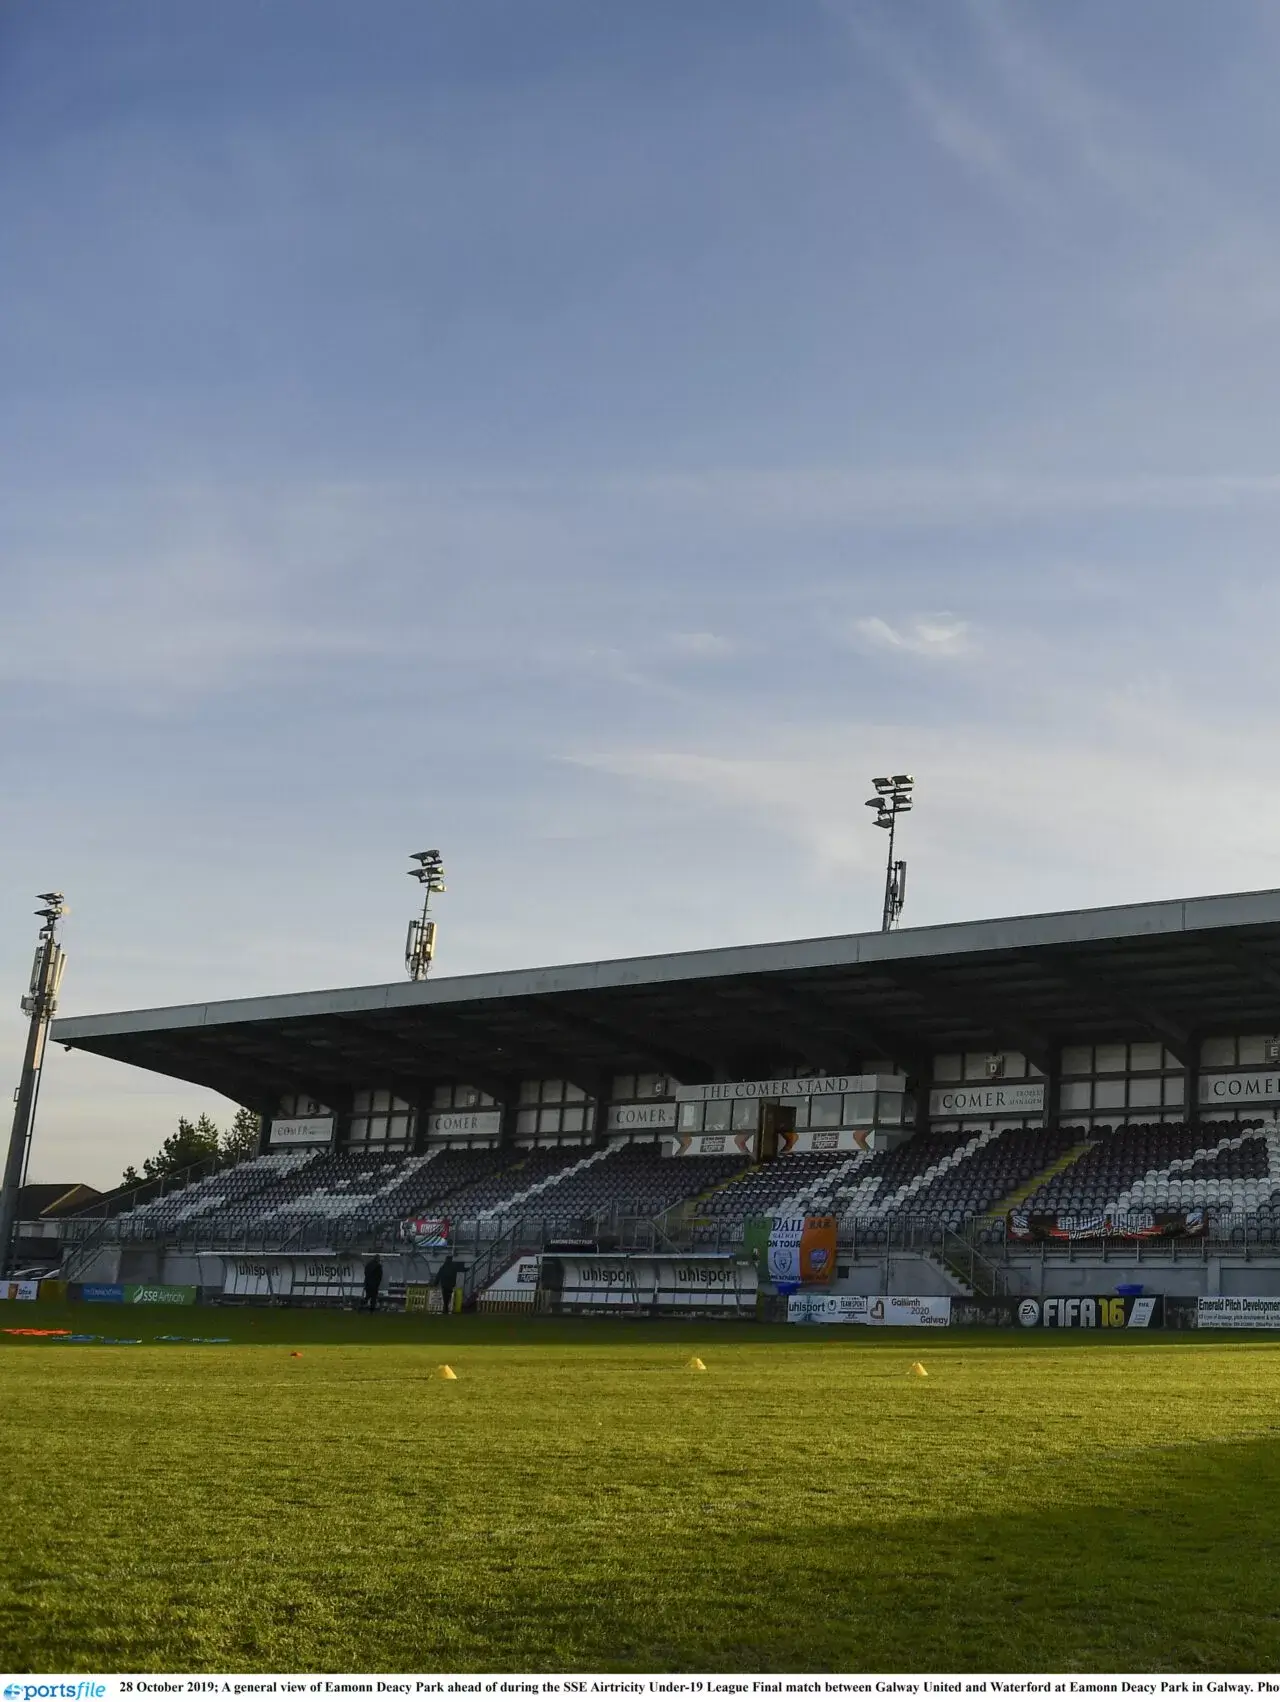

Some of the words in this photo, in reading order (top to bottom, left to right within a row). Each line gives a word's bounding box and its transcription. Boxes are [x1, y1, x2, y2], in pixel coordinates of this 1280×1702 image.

[702, 1084, 730, 1099] THE
[735, 1080, 790, 1097] COMER
[796, 1076, 850, 1094] STAND
[942, 1091, 1007, 1109] COMER
[435, 1114, 480, 1130] COMER
[616, 1108, 666, 1125] COMER
[277, 1125, 309, 1136] COMER
[1057, 1215, 1109, 1230] GALWAY
[1111, 1213, 1154, 1229] UNITED
[1093, 1226, 1127, 1238] NEVER
[143, 1291, 158, 1302] sse
[158, 1290, 185, 1304] Airtricity
[788, 1301, 825, 1314] uhlsport
[910, 1306, 930, 1315] 2020
[1022, 1304, 1036, 1314] EA
[1198, 1299, 1224, 1311] Emerald
[1225, 1299, 1241, 1311] Pitch
[1043, 1298, 1096, 1327] FIFA
[1098, 1298, 1125, 1327] 16
[920, 1314, 949, 1325] Galway
